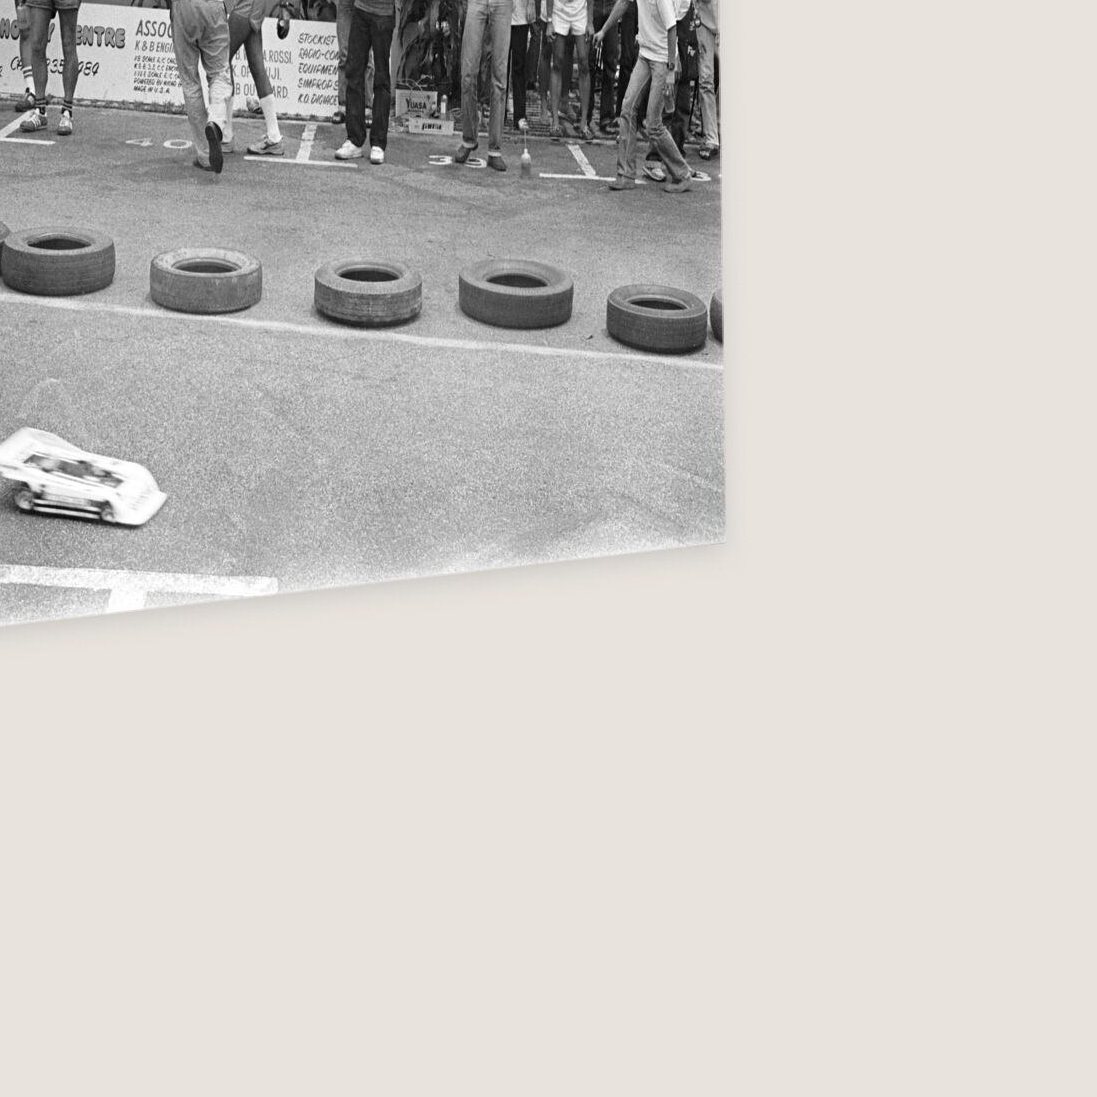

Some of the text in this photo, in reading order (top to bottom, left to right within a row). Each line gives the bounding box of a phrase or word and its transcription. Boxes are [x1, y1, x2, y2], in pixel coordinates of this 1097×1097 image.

[135, 19, 172, 38] ASSOC
[75, 24, 126, 49] ENTRE
[298, 62, 338, 75] EQUIPMEN
[405, 98, 427, 109] YUASA
[125, 137, 193, 149] 40
